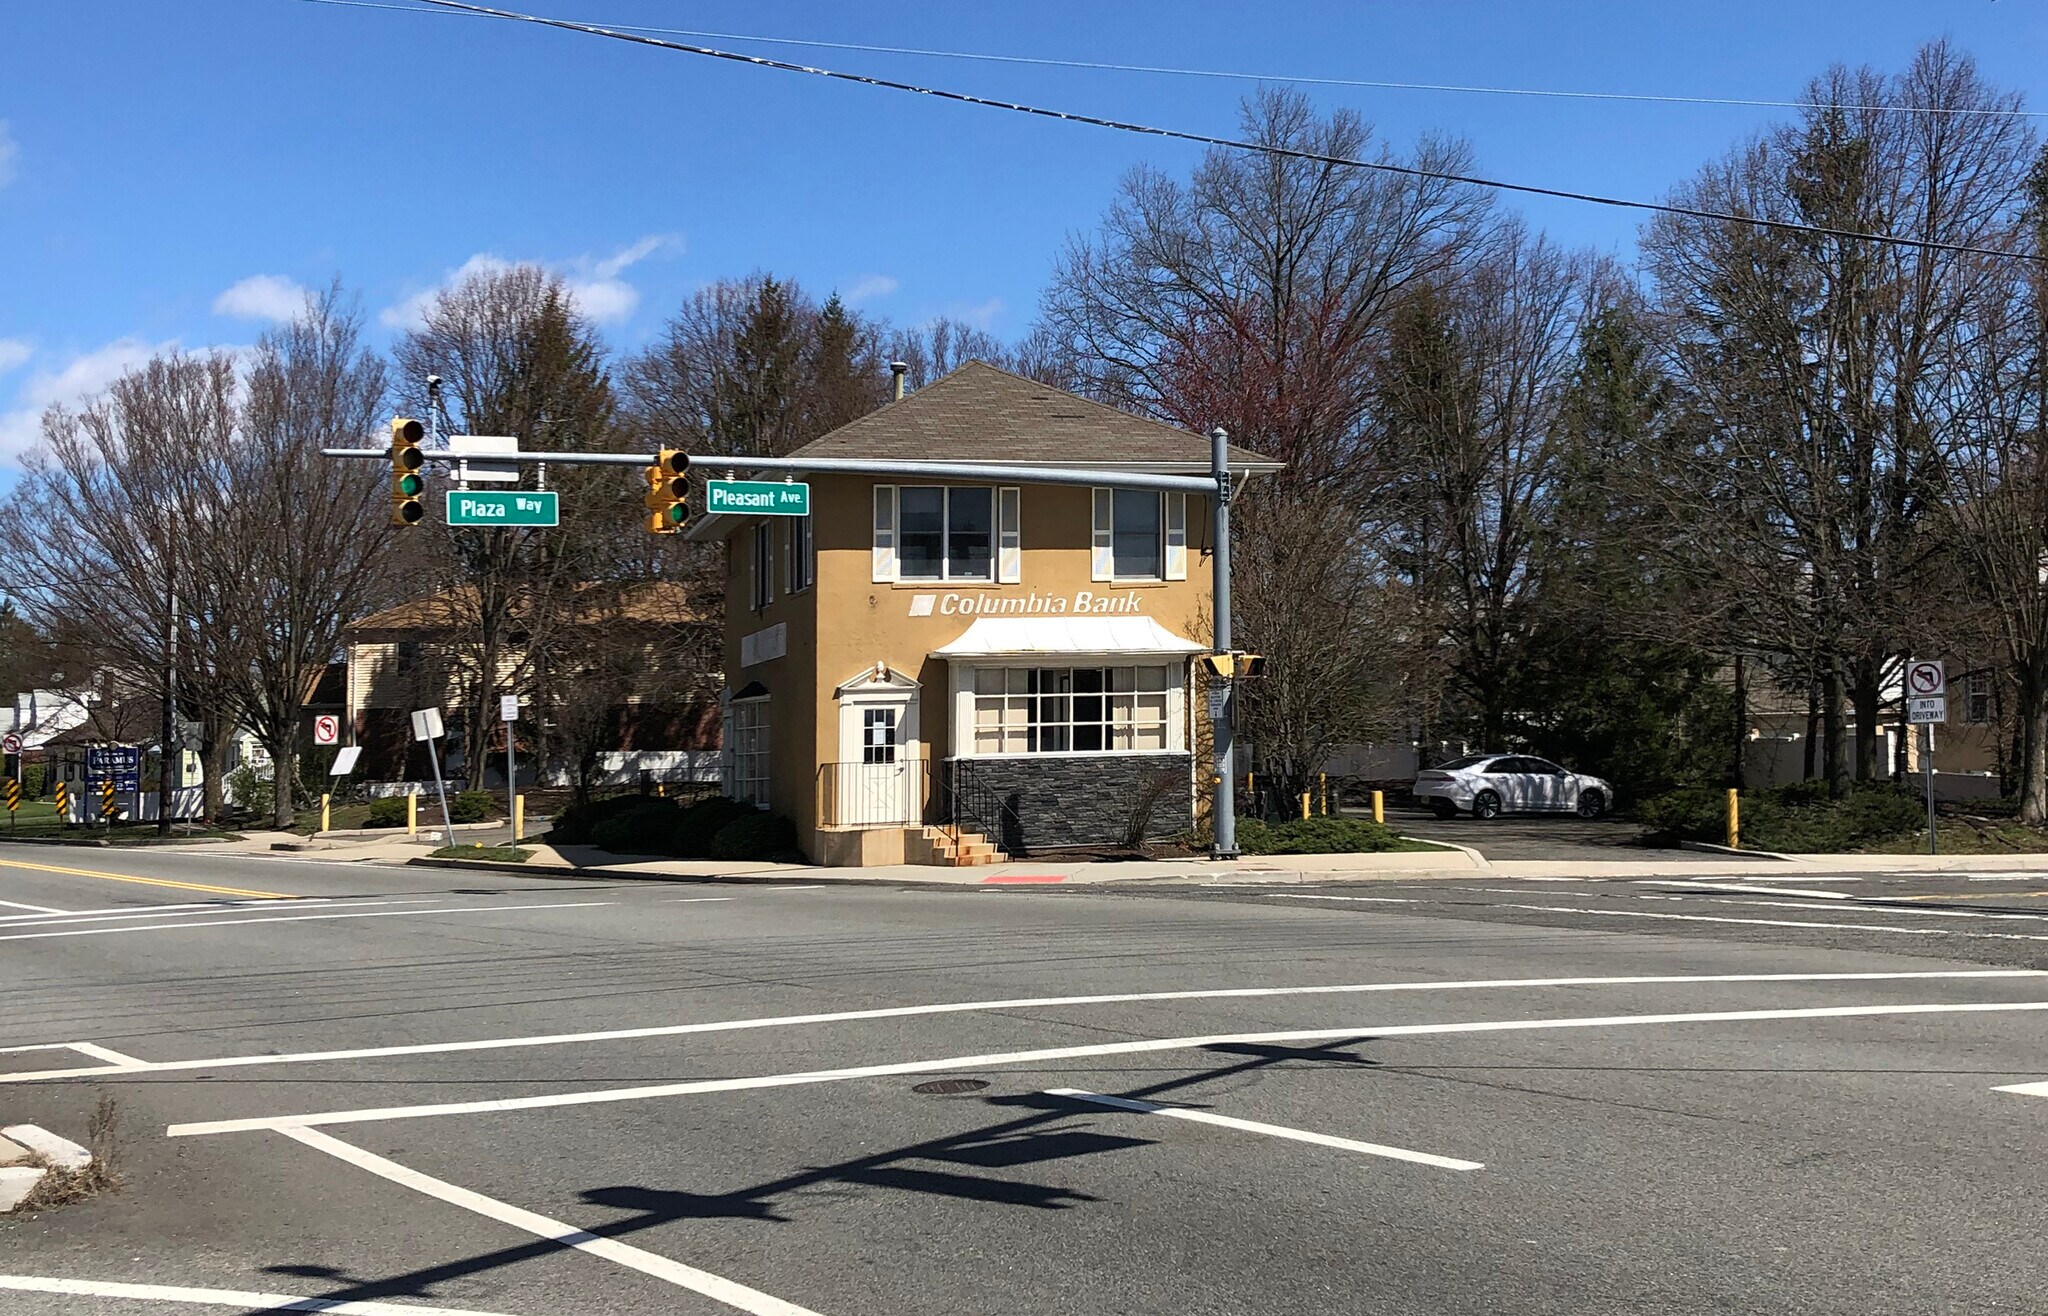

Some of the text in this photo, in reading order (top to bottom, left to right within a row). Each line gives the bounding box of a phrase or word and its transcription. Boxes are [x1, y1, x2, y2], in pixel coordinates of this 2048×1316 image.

[712, 488, 804, 507] Pleasant Ave.
[460, 497, 543, 517] Plaza Way
[939, 591, 1143, 615] Columbia Bank
[1919, 699, 1935, 709] INTO
[1912, 710, 1944, 721] DRIVEWAY
[92, 756, 134, 765] PARAMUS
